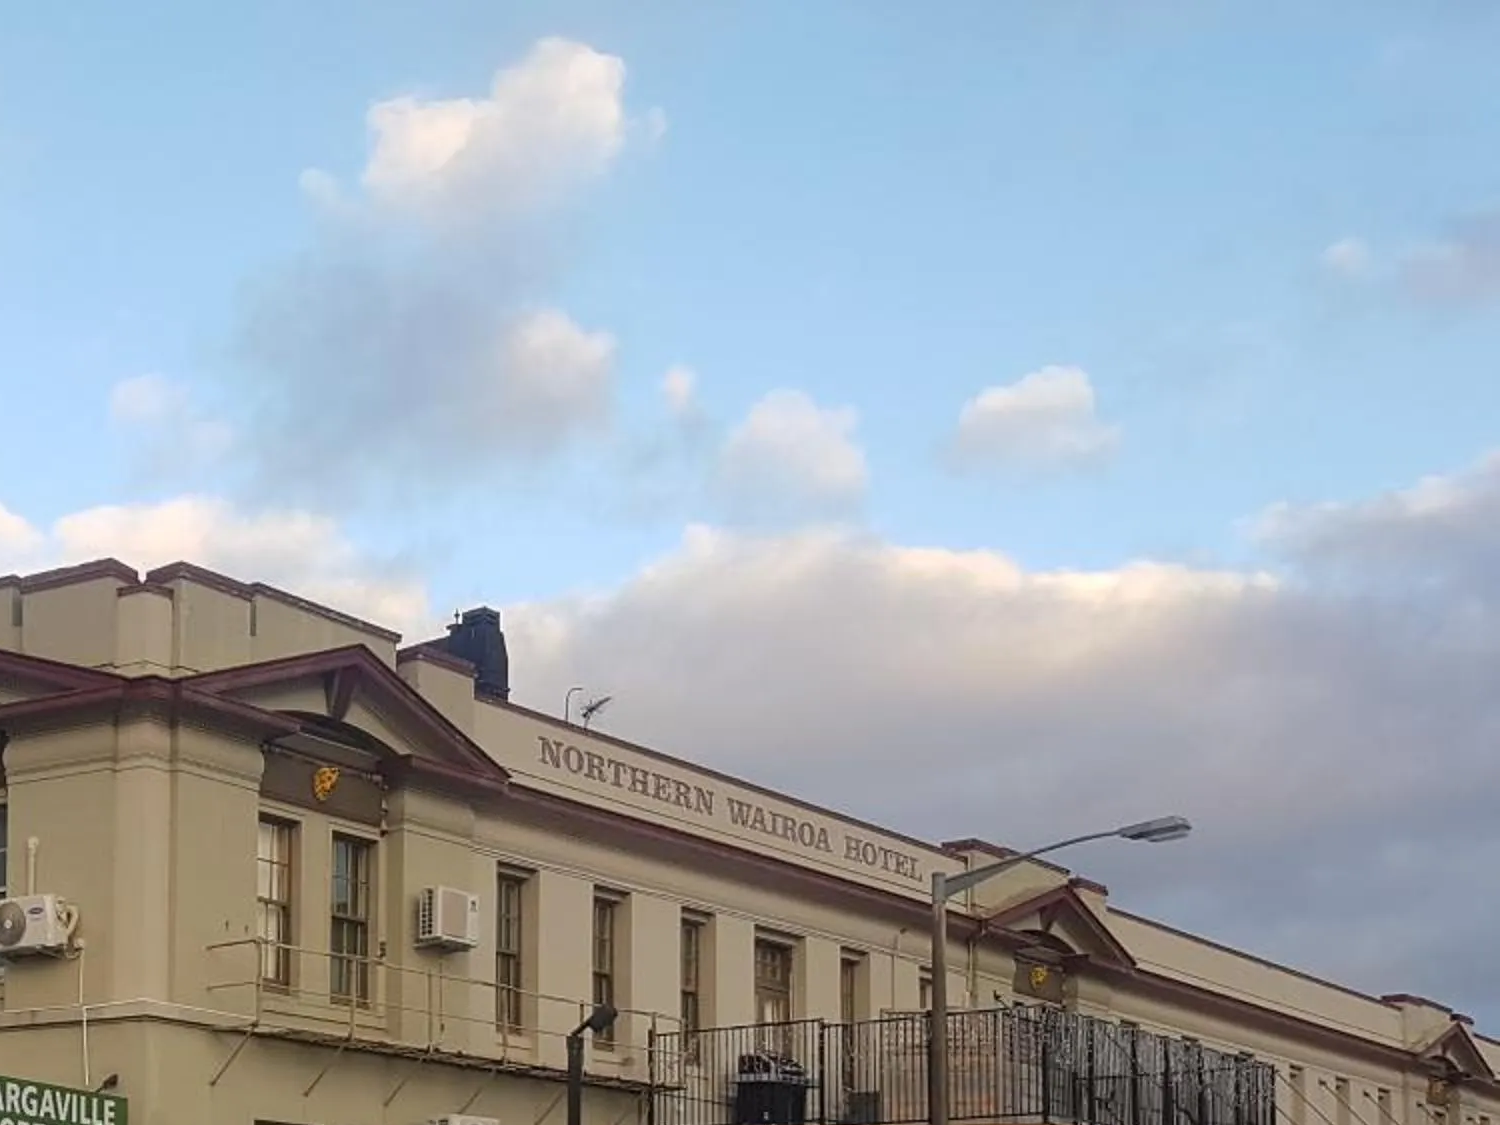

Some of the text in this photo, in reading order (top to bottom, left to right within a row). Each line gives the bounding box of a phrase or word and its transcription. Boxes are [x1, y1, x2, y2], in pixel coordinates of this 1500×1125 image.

[538, 735, 924, 882] NORTHERN WAIROA HOTEL
